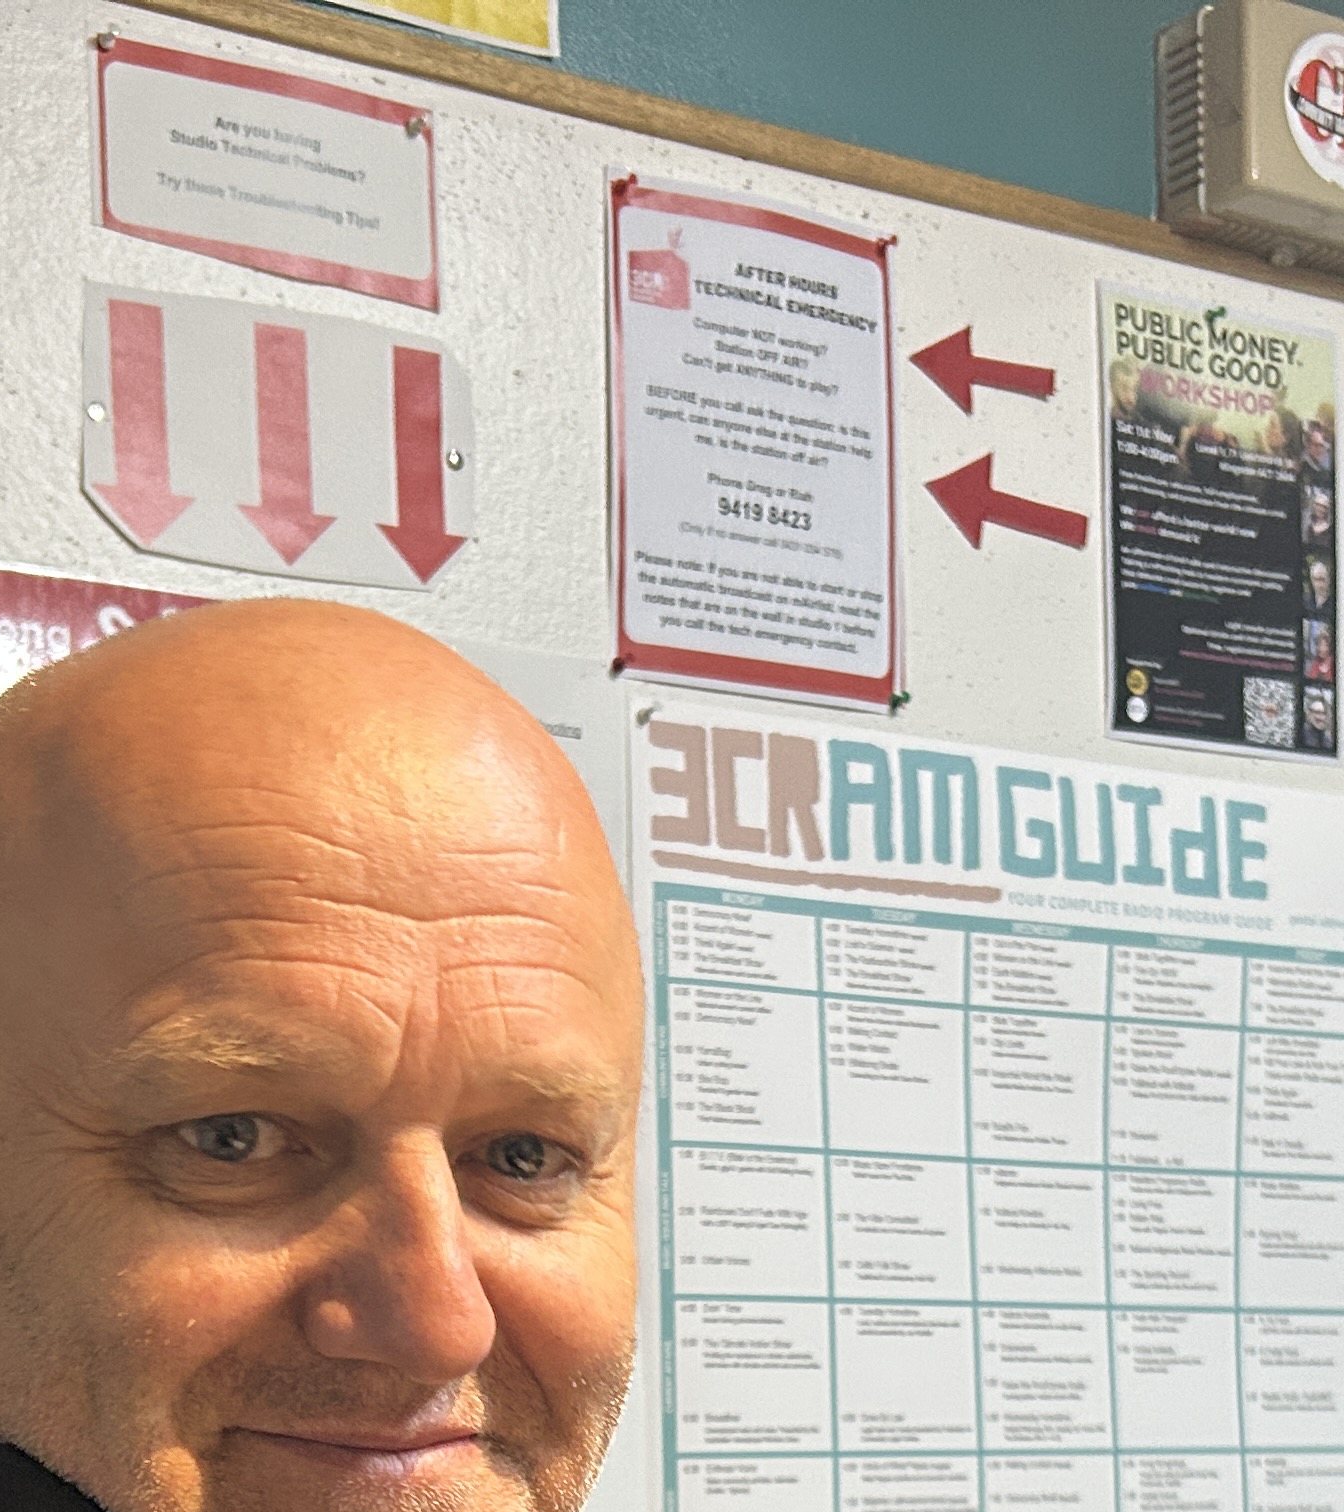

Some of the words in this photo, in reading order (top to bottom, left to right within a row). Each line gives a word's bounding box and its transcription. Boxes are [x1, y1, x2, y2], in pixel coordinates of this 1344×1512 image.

[169, 129, 218, 151] Studio
[734, 262, 786, 288] AFTER
[788, 275, 840, 300] HOURS
[693, 279, 782, 311] TECHNICAL
[785, 299, 878, 334] EMERGENCY
[1114, 302, 1203, 347] PUBLIC
[1116, 331, 1204, 375] PUBLIC
[1138, 366, 1276, 416] WORKSHOP
[718, 496, 763, 522] 9419
[767, 505, 812, 531] 8423
